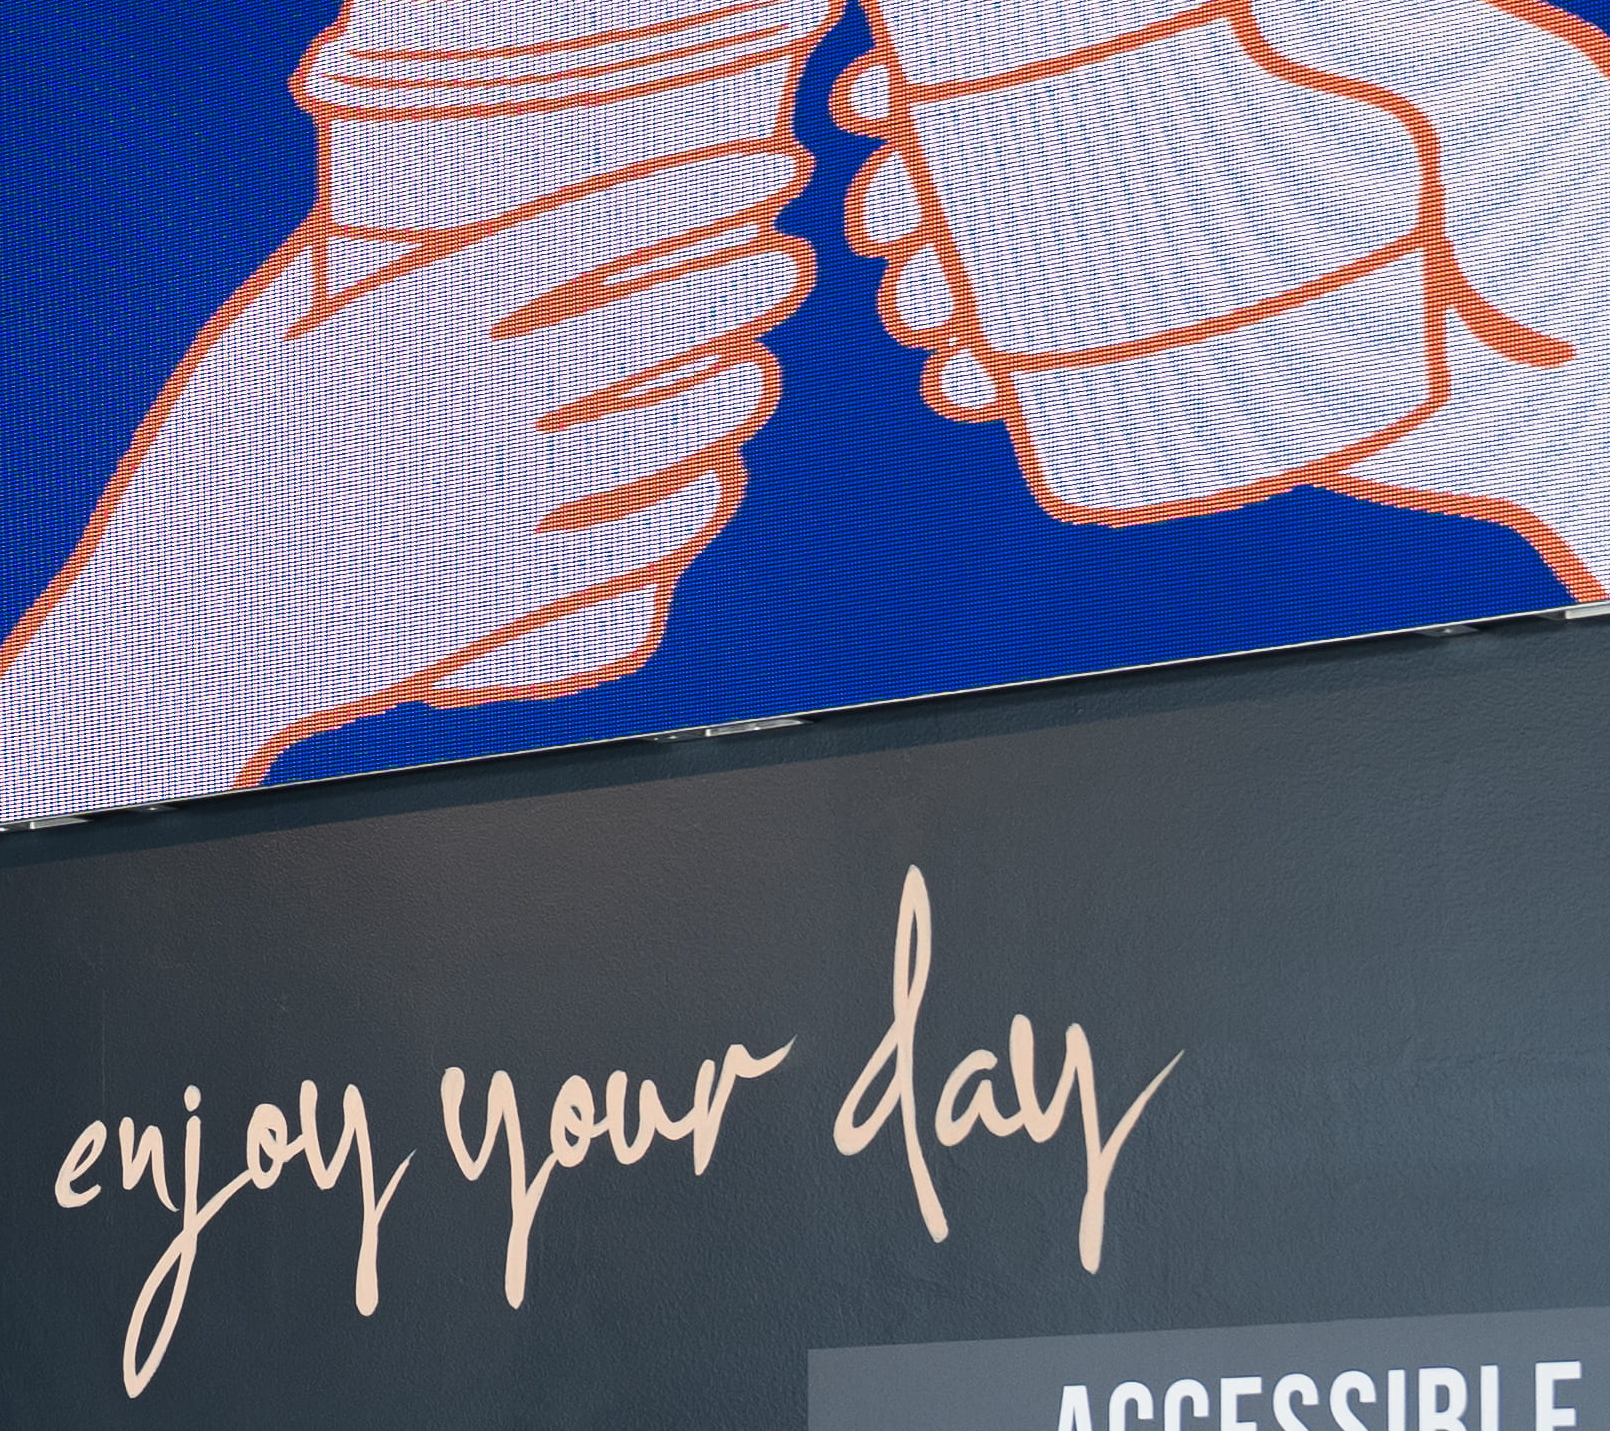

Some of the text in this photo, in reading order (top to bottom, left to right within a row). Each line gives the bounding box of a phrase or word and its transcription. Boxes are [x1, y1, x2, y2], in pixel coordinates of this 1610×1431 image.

[54, 865, 1184, 1399] enjoy your day
